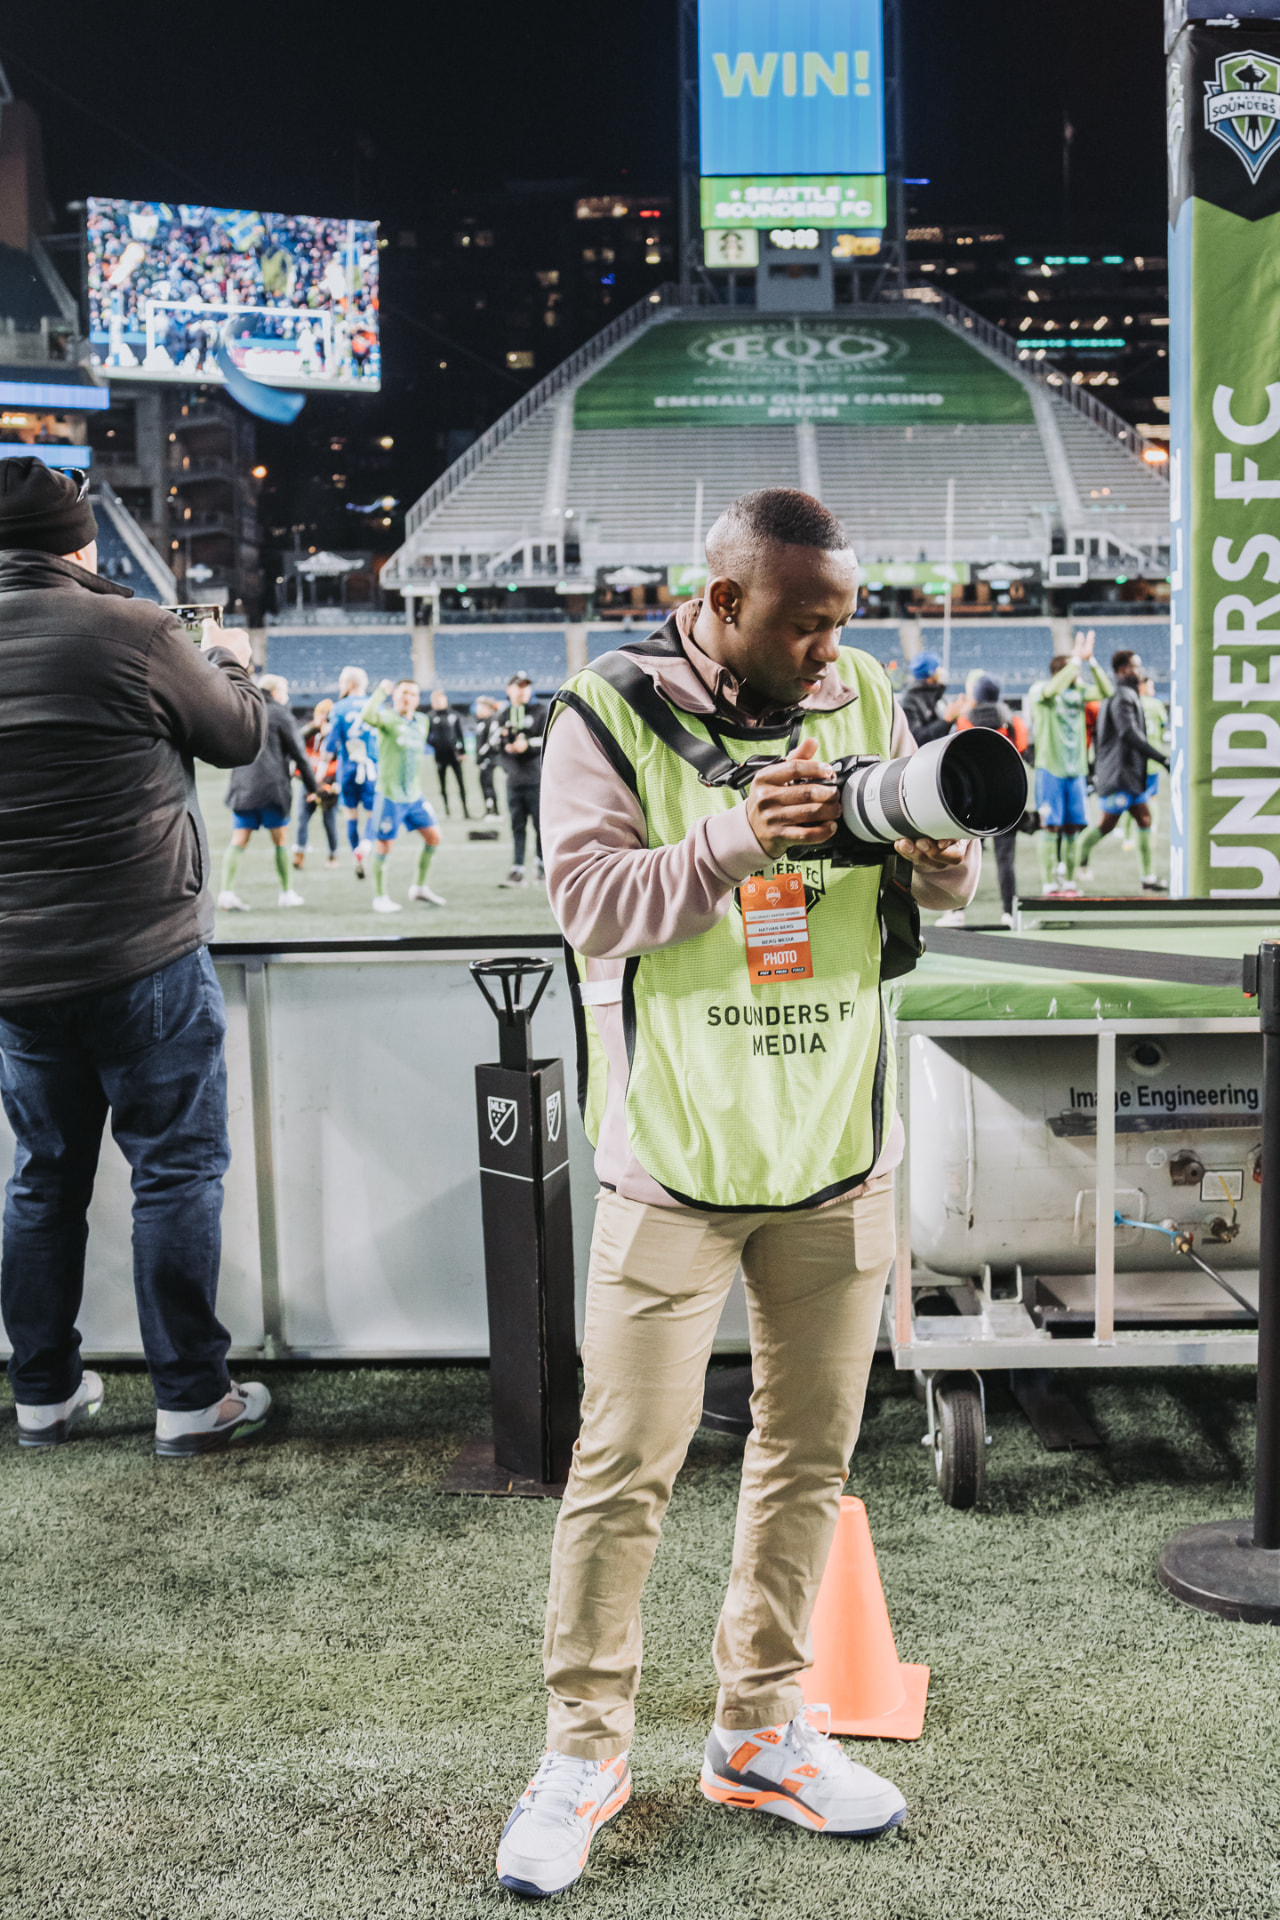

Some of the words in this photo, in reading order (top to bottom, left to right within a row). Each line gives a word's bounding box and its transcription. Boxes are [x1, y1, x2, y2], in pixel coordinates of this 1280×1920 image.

[713, 51, 870, 97] WIN!
[1212, 100, 1276, 118] SOUNDERS
[744, 186, 842, 201] SEATTLE
[715, 201, 837, 218] SOUNDERS
[841, 201, 872, 217] FC
[706, 334, 889, 366] EQC
[654, 395, 755, 408] EMERALD
[770, 393, 849, 406] QUEEN
[853, 393, 944, 406] CASINO
[1212, 381, 1280, 505] FC
[806, 866, 819, 884] FC
[763, 950, 797, 966] PHOTO
[707, 1003, 829, 1027] SOUNDERS
[839, 1001, 855, 1021] F
[752, 1032, 827, 1056] MEDIA
[490, 1101, 506, 1113] MLS
[1070, 1087, 1131, 1112] Ime
[1137, 1084, 1259, 1111] Engineering
